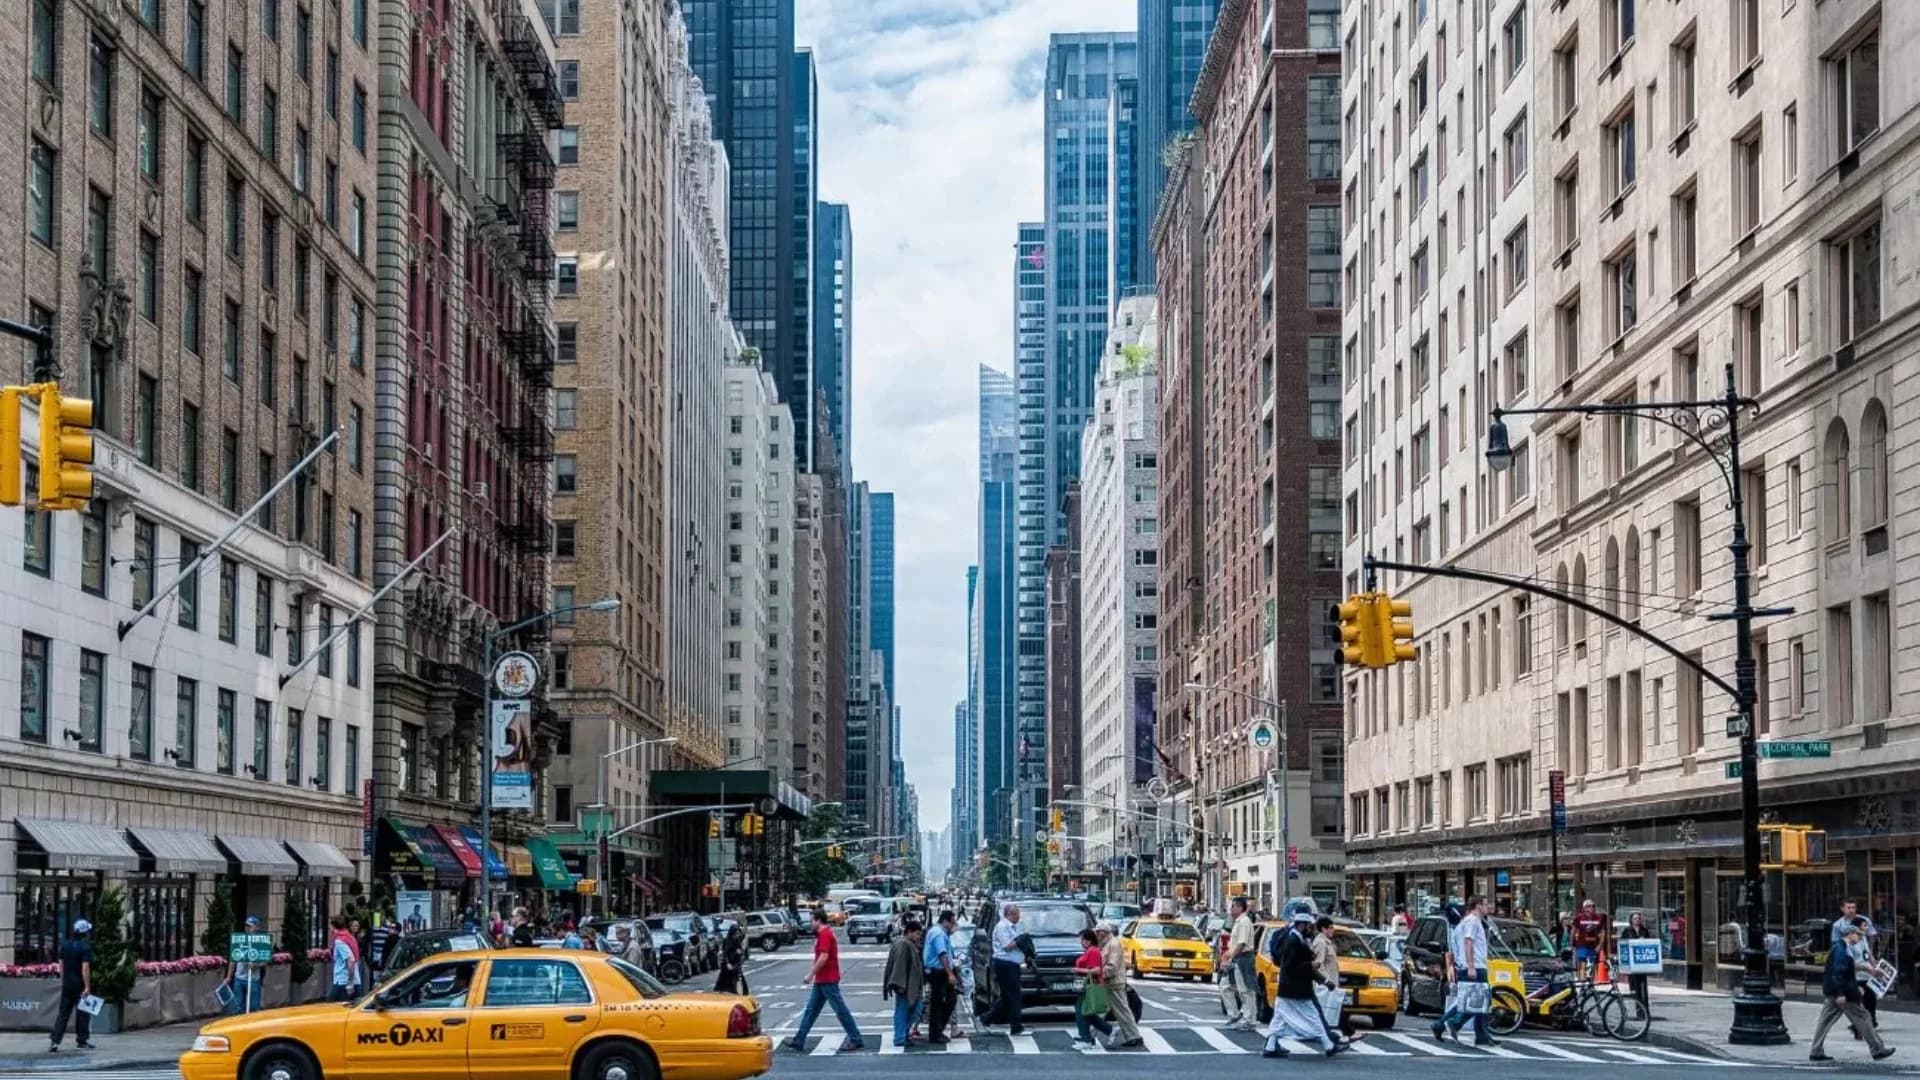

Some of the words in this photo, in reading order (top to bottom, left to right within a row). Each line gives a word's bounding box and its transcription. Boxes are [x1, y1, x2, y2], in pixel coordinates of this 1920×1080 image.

[502, 703, 521, 711] NYC
[1770, 743, 1806, 753] CENTRAL
[1808, 743, 1831, 753] PARK
[357, 1033, 388, 1045] NYC
[389, 1023, 444, 1046] TAXI
